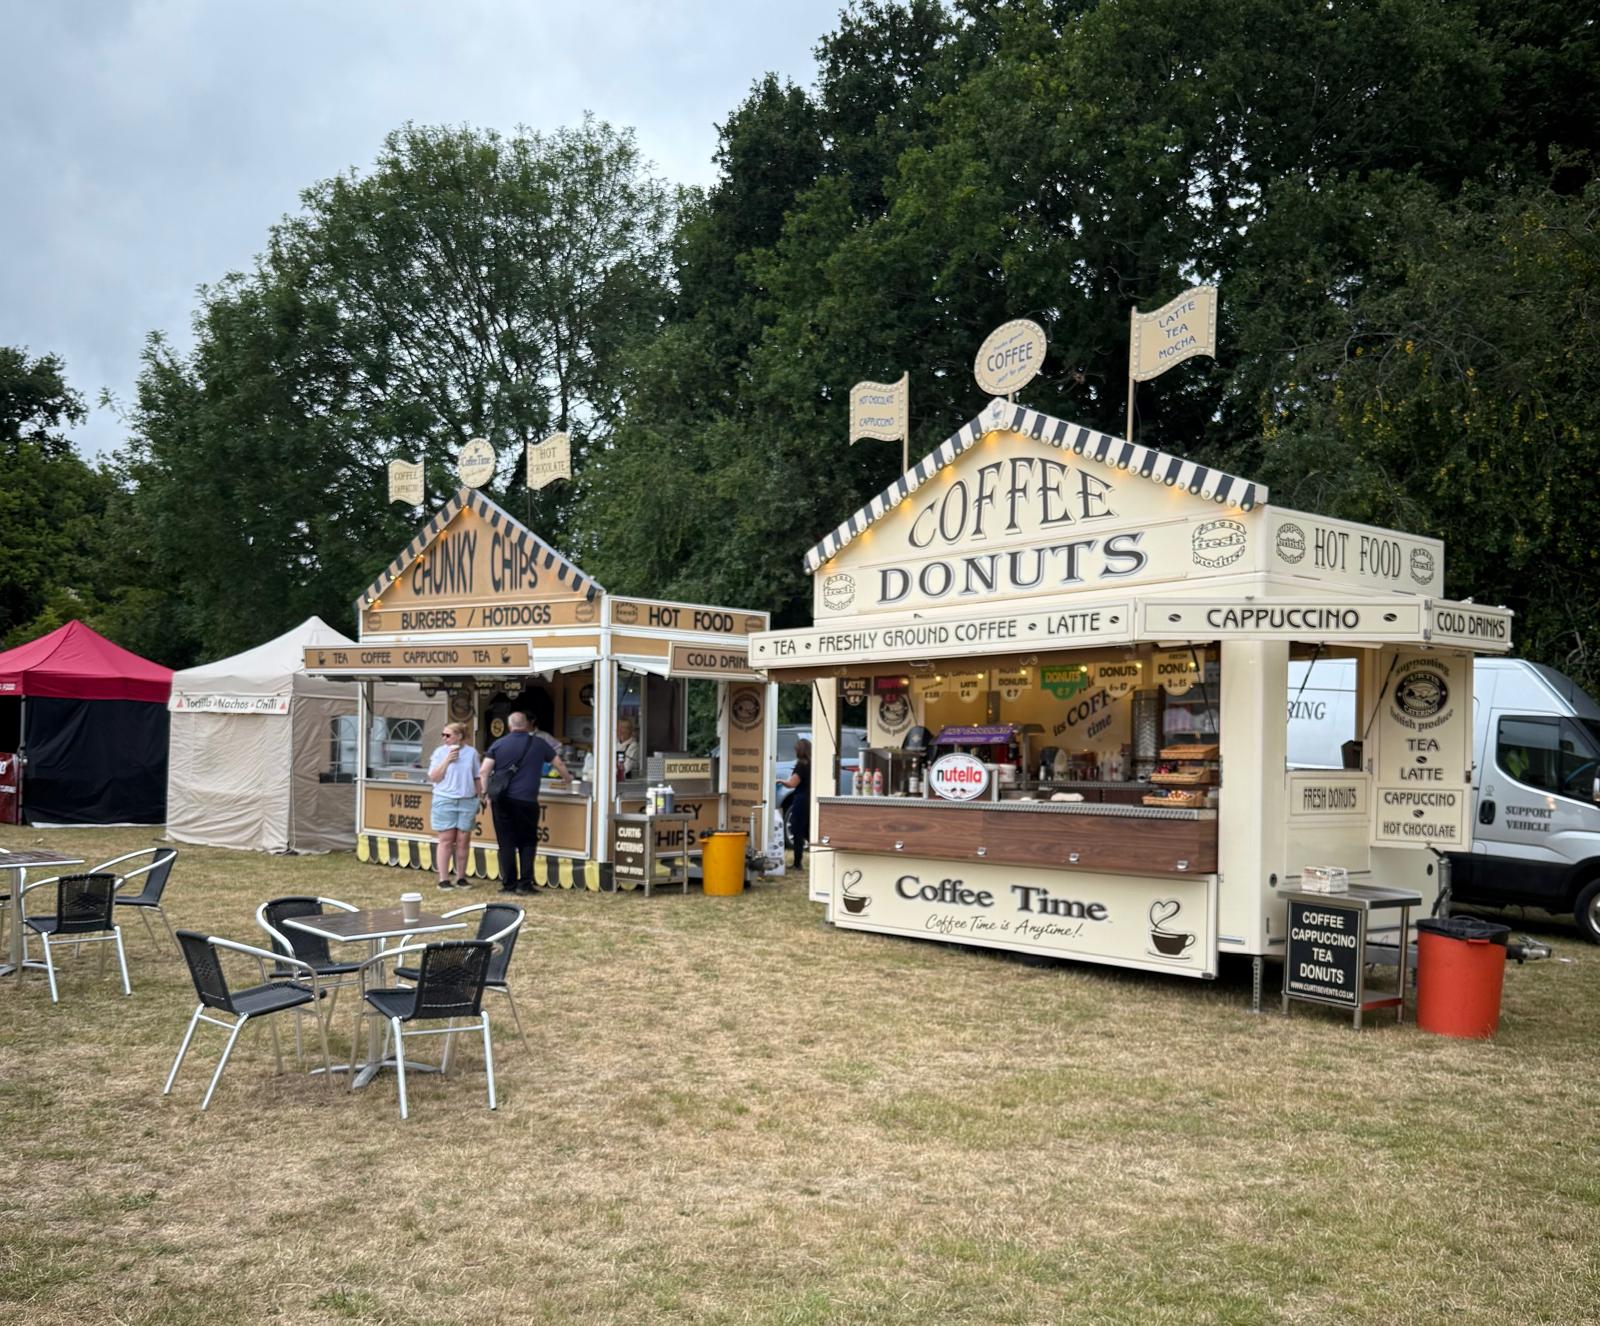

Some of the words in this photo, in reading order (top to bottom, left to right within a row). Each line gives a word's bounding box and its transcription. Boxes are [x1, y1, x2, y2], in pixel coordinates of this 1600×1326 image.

[1159, 301, 1195, 328] LATTE
[1166, 323, 1188, 338] TEA
[1159, 335, 1196, 358] MOCHA
[987, 341, 1033, 372] COFFEE
[908, 457, 1118, 548] COFFEE
[1192, 533, 1246, 551] fresh
[412, 529, 477, 595] CHUNKY
[491, 531, 538, 593] CHIPS
[1315, 528, 1349, 570] HOT
[1360, 535, 1401, 579] FOOD
[877, 531, 1148, 605] DONUTS
[401, 610, 456, 630] BURGERS
[482, 605, 552, 627] HOTDOGS
[649, 607, 680, 627] HOT
[694, 611, 734, 632] FOOD
[1207, 609, 1360, 629] CAPPUCCINO
[1437, 612, 1465, 634] COLD
[1469, 615, 1506, 638] DRINKS
[773, 639, 796, 655] TEA
[819, 632, 877, 652] FRESHLY
[883, 627, 949, 647] GROUND
[956, 620, 1017, 640] COFFEE
[1048, 613, 1100, 634] LATTE
[333, 653, 348, 664] TEA
[361, 652, 391, 664] COFFEE
[403, 650, 459, 663] CAPPUCCINO
[473, 650, 490, 663] TEA
[687, 653, 716, 667] COLD
[720, 655, 749, 668] DRIN
[1099, 665, 1137, 678] DONUTS
[186, 698, 212, 708] Tortilla
[218, 698, 249, 709] Nachos
[1087, 713, 1112, 738] time
[1407, 739, 1439, 751] TEA
[679, 763, 709, 773] CHOCOLATE
[937, 766, 982, 783] nutella
[1400, 768, 1443, 781] LATTE
[390, 794, 401, 807] 1/4
[404, 794, 422, 808] BEEF
[1303, 787, 1326, 810] FRESH
[1328, 788, 1357, 809] DONUTS
[1384, 792, 1455, 806] CAPPUCCINO
[1505, 805, 1552, 818] SUPPORT
[389, 814, 424, 831] BURGERS
[1383, 822, 1401, 834] HOT
[1403, 823, 1456, 837] CHOCOLATE
[1506, 820, 1550, 832] VEHICLE
[655, 830, 695, 847] HIPS
[896, 875, 994, 907] Coffee
[1011, 884, 1108, 922] Time
[925, 914, 967, 934] Coffee
[970, 916, 996, 932] Time
[1000, 920, 1009, 930] is
[1013, 921, 1083, 939] Anytime!
[1302, 912, 1344, 929] COFFEE
[1291, 928, 1356, 948] CAPPUCCINO
[1312, 947, 1334, 963] TEA
[1300, 963, 1344, 984] DONUTS
[1291, 981, 1354, 1000] WWW.CURTISEVENTS.CO.UK
